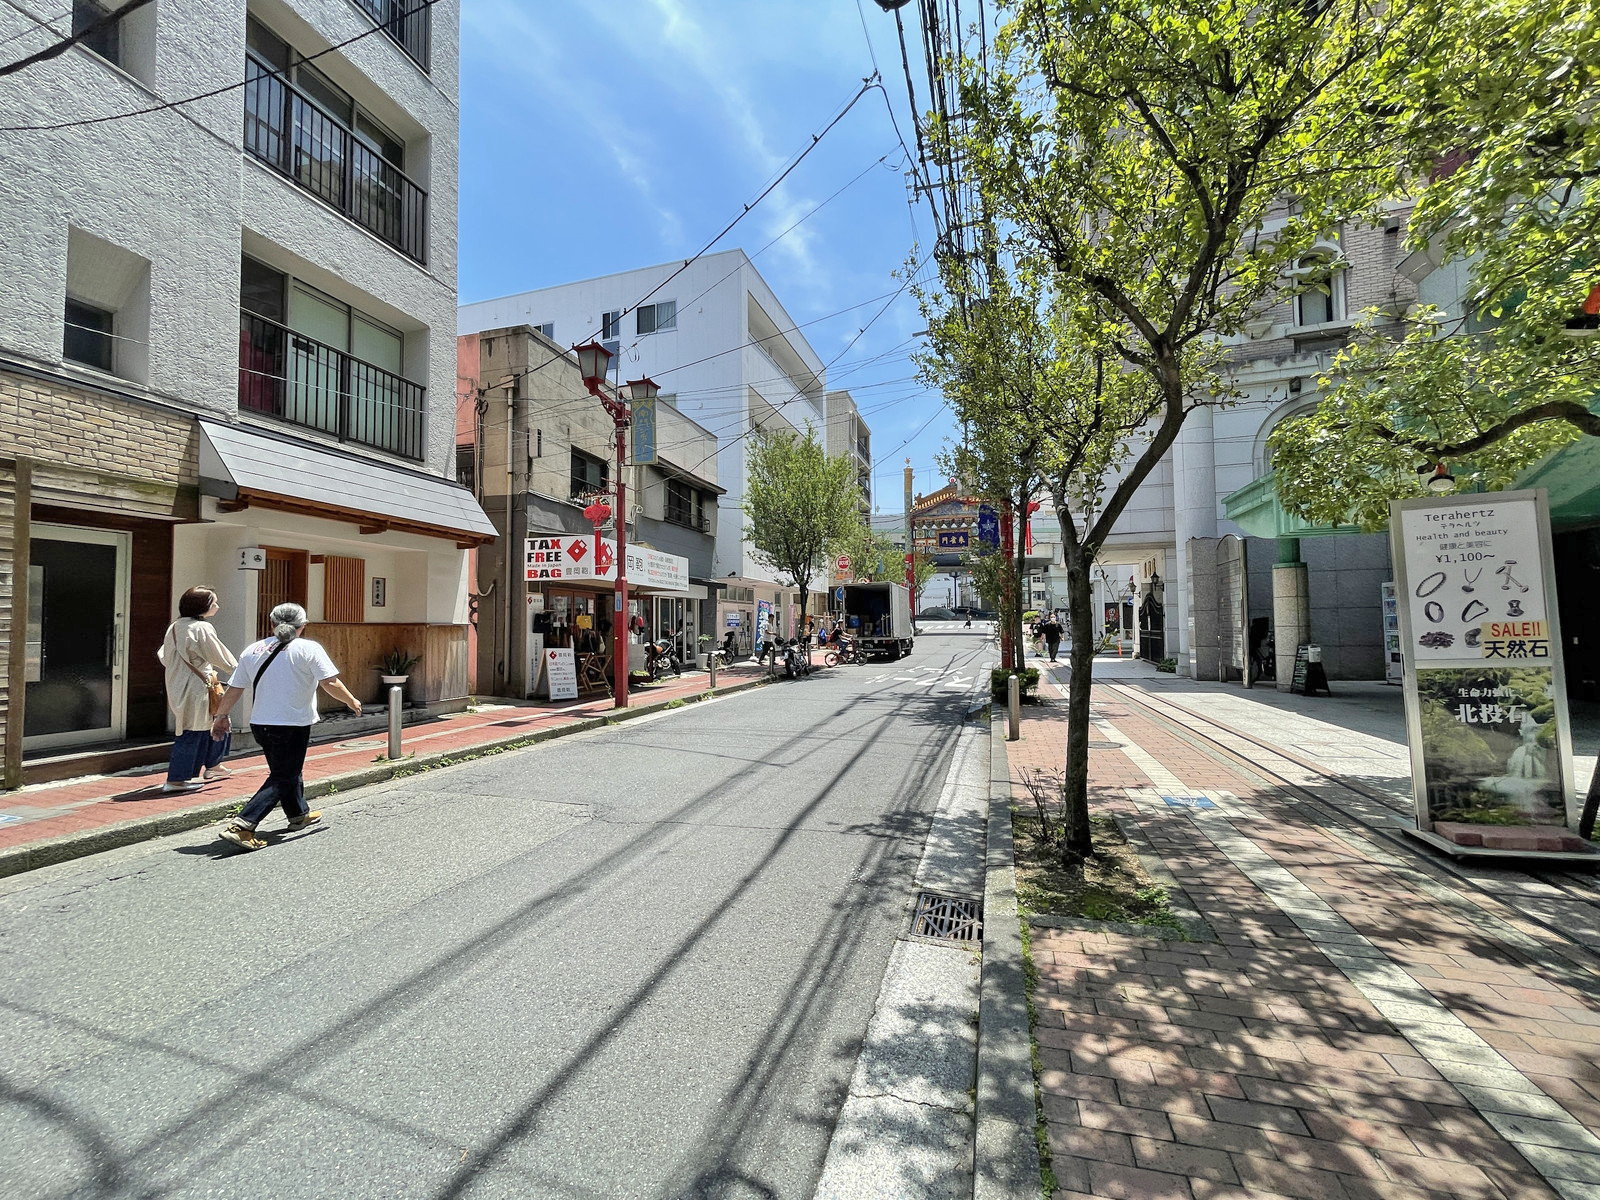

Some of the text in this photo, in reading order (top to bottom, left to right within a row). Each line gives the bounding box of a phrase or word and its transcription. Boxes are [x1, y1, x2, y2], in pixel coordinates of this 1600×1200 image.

[1424, 509, 1495, 522] Terahertz
[1440, 521, 1480, 529] テラヘルツ
[1416, 528, 1508, 541] Health and beauty
[527, 539, 562, 550] TAX
[1439, 540, 1492, 551] 健康と美容に
[527, 552, 562, 562] FREE
[527, 568, 562, 578] BAG
[1491, 621, 1541, 637] SALE!!
[1484, 639, 1549, 659] 天然石
[1454, 703, 1528, 724] 北投石
